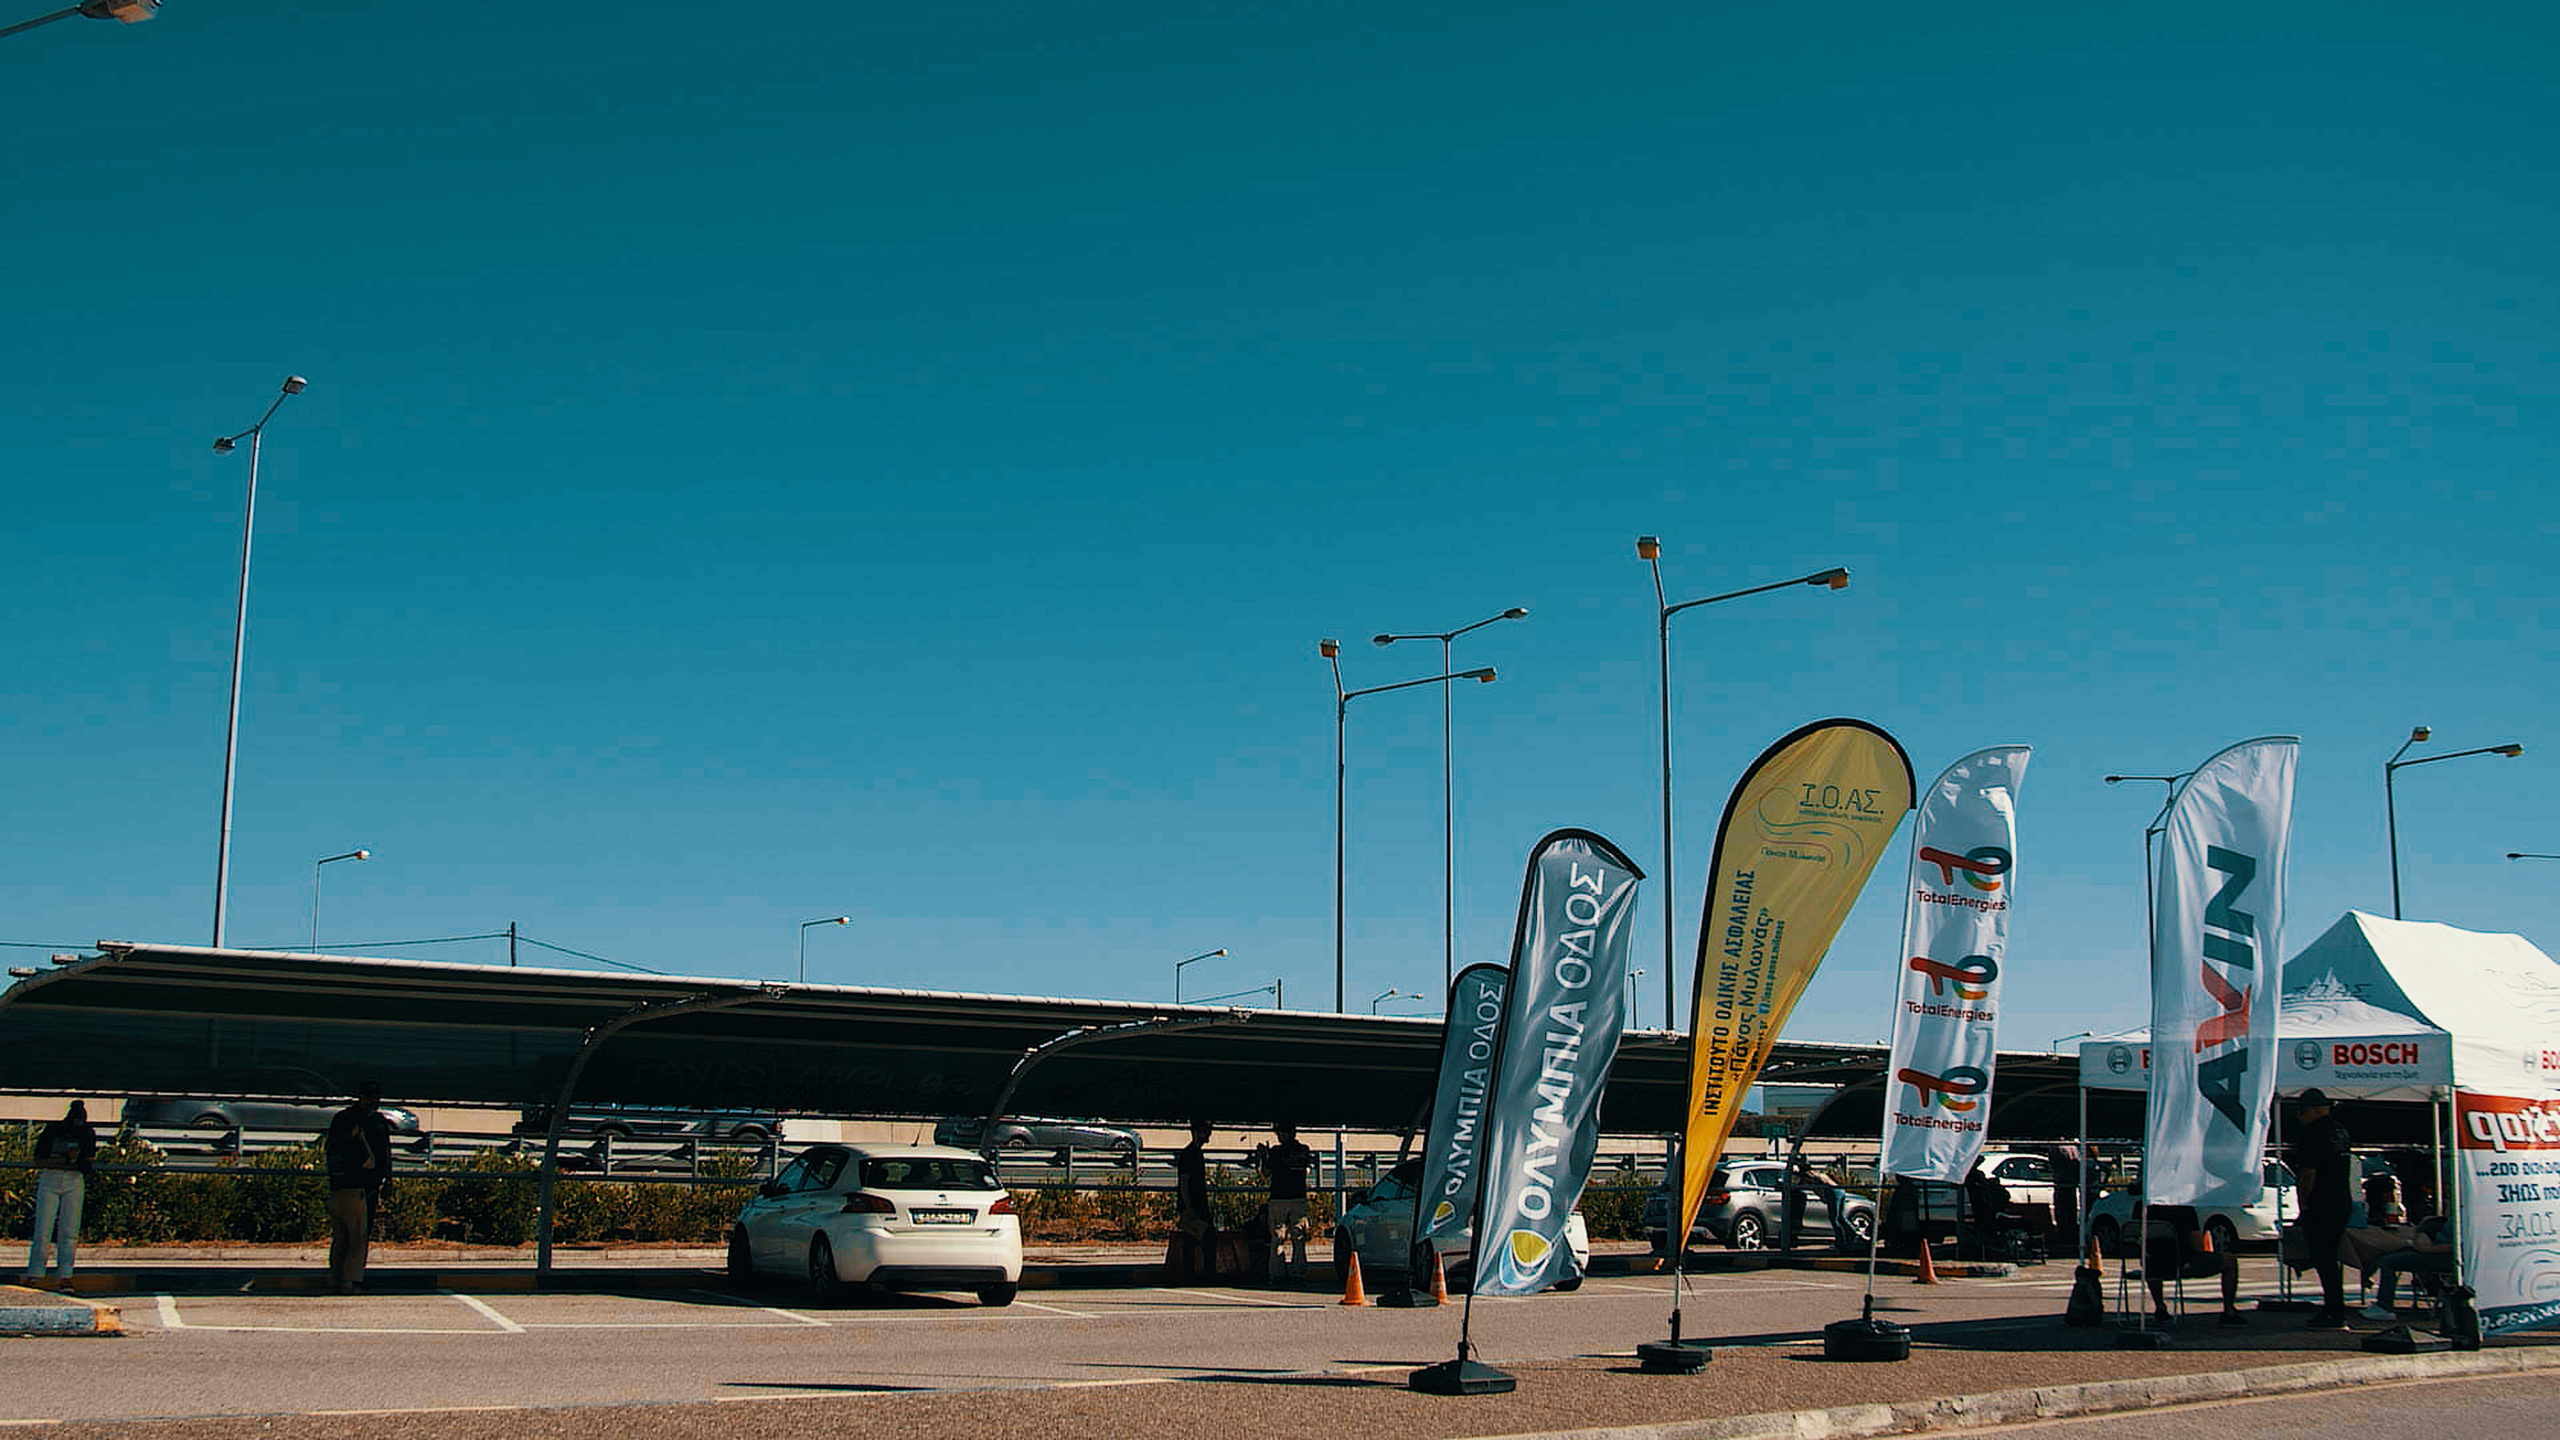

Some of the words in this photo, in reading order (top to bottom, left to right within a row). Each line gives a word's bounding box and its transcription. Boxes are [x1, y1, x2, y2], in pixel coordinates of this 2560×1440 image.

[1723, 869, 1755, 959] ΑΣΦΑΛΕΙΑΣ
[1916, 890, 2007, 912] TotalEnergies
[1715, 962, 1739, 1020] ΟΔΙΚΗΣ
[1906, 1001, 1994, 1022] TotalEnergies
[2195, 844, 2257, 1135] AVIN
[1517, 1001, 1588, 1222] ΟΛΥΜΠΙΑ
[1555, 862, 1605, 989] ΟΔΟΣ
[1704, 1026, 1730, 1115] ΙΝΣΤΙΤΟΥΤΟ
[2333, 1043, 2419, 1065] BOSCH
[1445, 1067, 1488, 1196] ΟΛΥΜΠΙΑ
[1468, 982, 1504, 1060] ΟΔΟΣ
[1893, 1112, 1982, 1133] TotalEnergies
